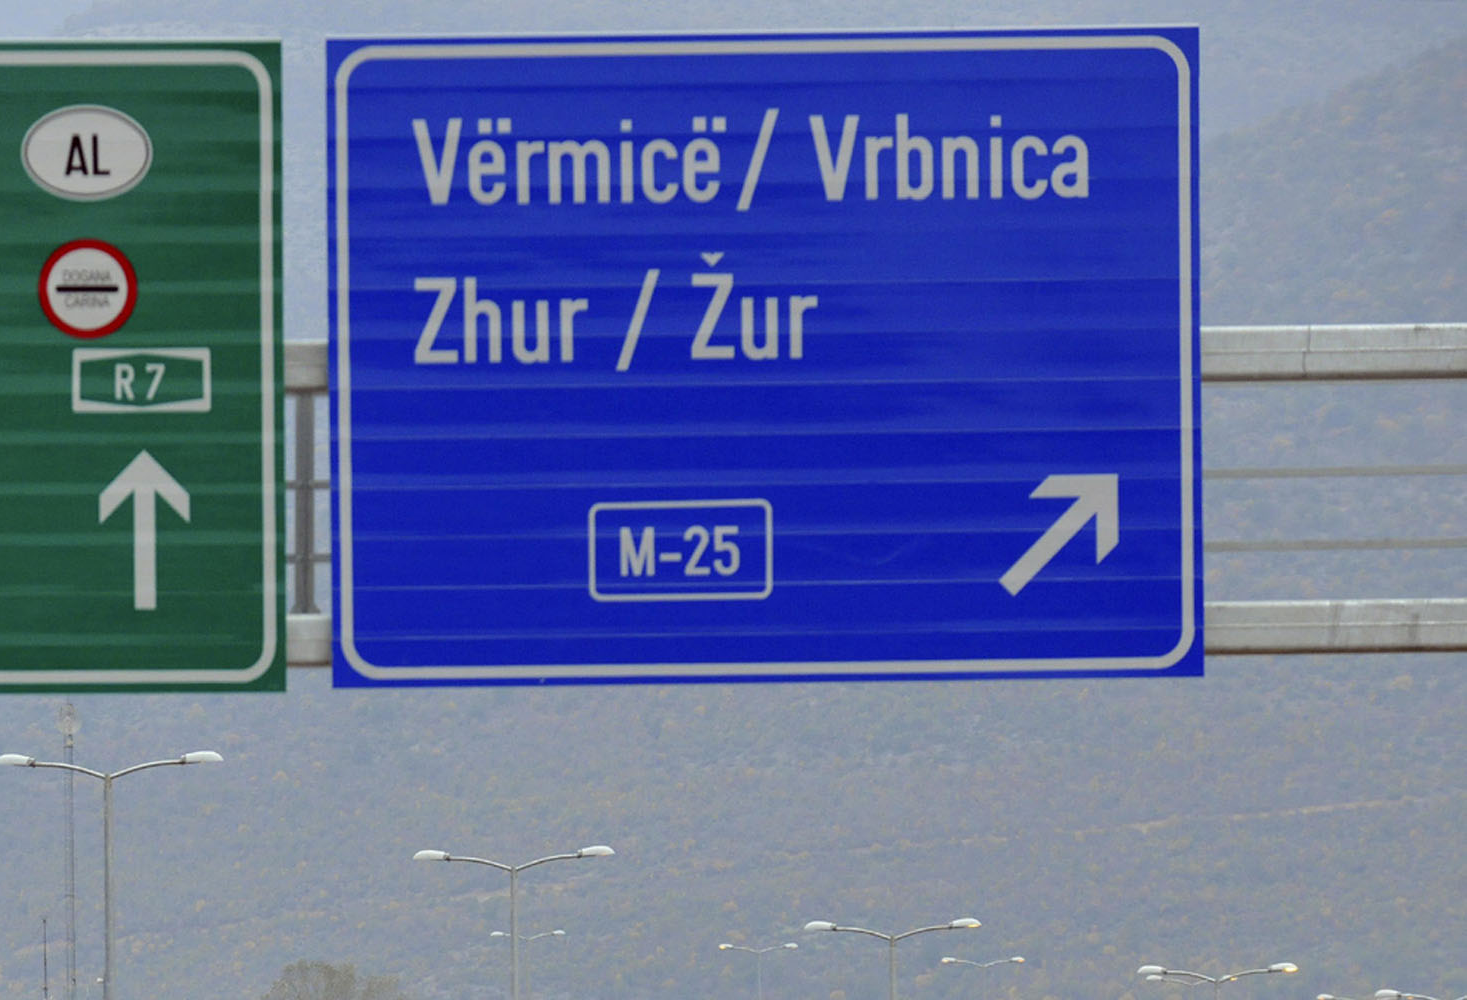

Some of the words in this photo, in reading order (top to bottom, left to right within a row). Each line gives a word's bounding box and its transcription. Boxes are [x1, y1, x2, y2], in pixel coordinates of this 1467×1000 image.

[65, 134, 111, 176] AL
[412, 115, 727, 206] Vërmicë
[736, 108, 779, 211] /
[809, 113, 1090, 202] Vrbnica
[63, 268, 111, 281] DOGANA
[64, 294, 110, 308] CARINA
[414, 276, 589, 364] Zhur
[616, 268, 660, 372] /
[691, 252, 819, 360] Žur
[114, 363, 135, 400] R
[145, 363, 166, 400] 7
[619, 525, 740, 577] M-25
